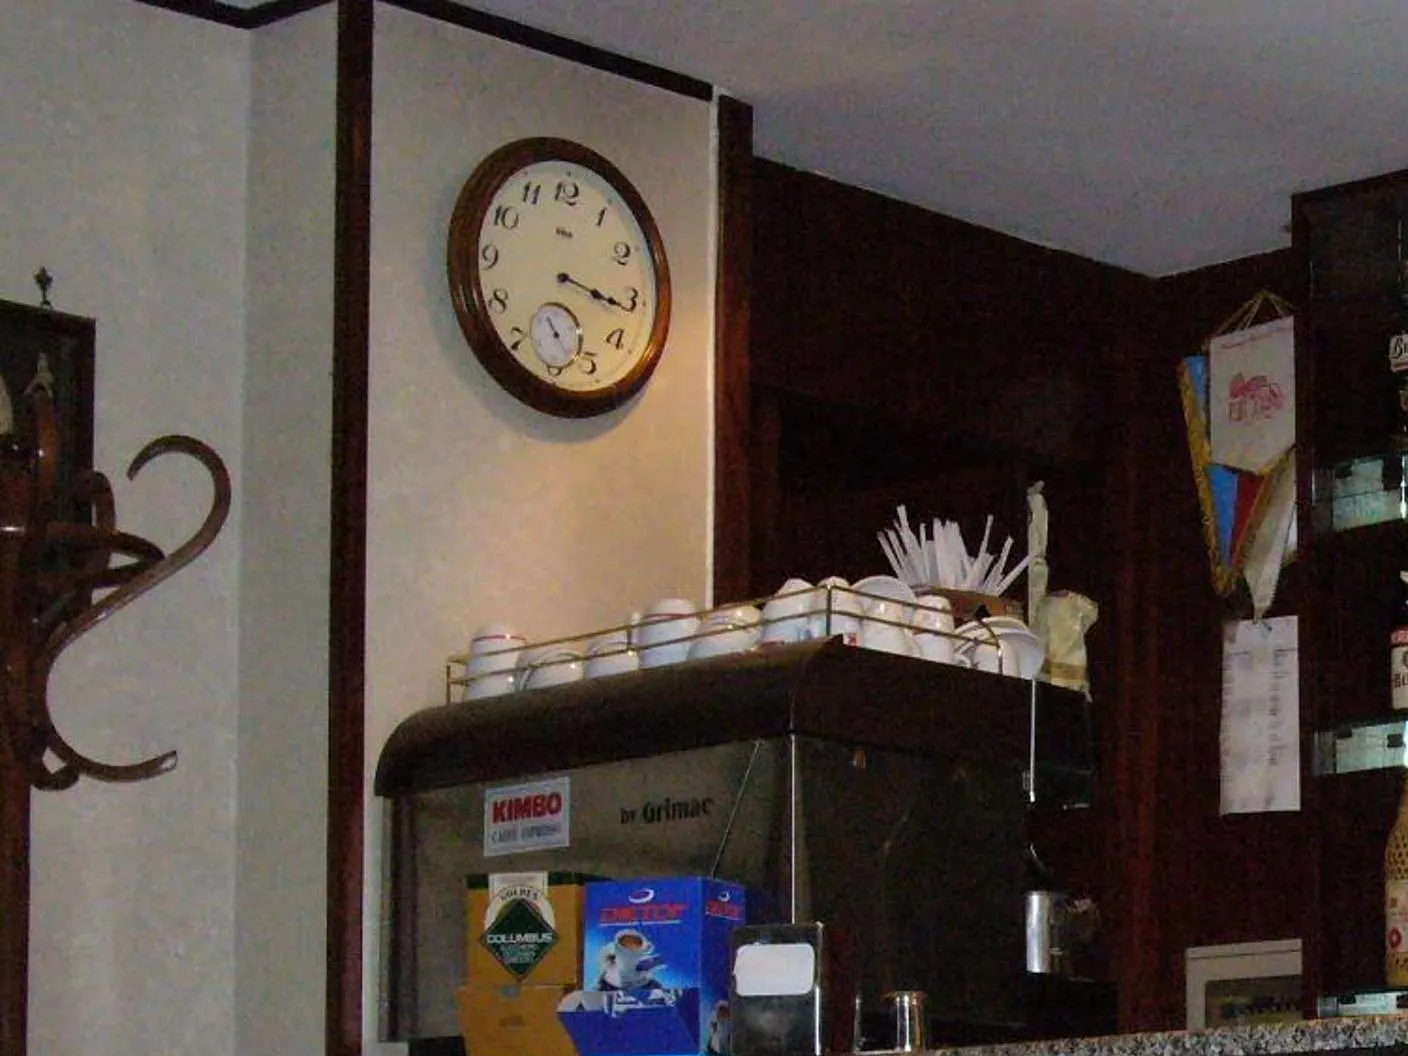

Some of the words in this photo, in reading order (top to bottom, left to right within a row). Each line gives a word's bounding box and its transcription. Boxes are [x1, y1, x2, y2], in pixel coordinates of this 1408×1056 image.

[522, 181, 542, 205] 11
[554, 181, 580, 206] 12
[494, 205, 520, 229] 10
[595, 207, 607, 227] 1
[482, 244, 499, 270] 9
[613, 242, 631, 265] 2
[488, 288, 508, 313] 8
[622, 288, 640, 312] 3
[511, 327, 527, 350] 7
[606, 328, 625, 350] 4
[578, 351, 597, 375] 5
[492, 792, 563, 823] KIMBO
[487, 931, 553, 944] COLUMBUS
